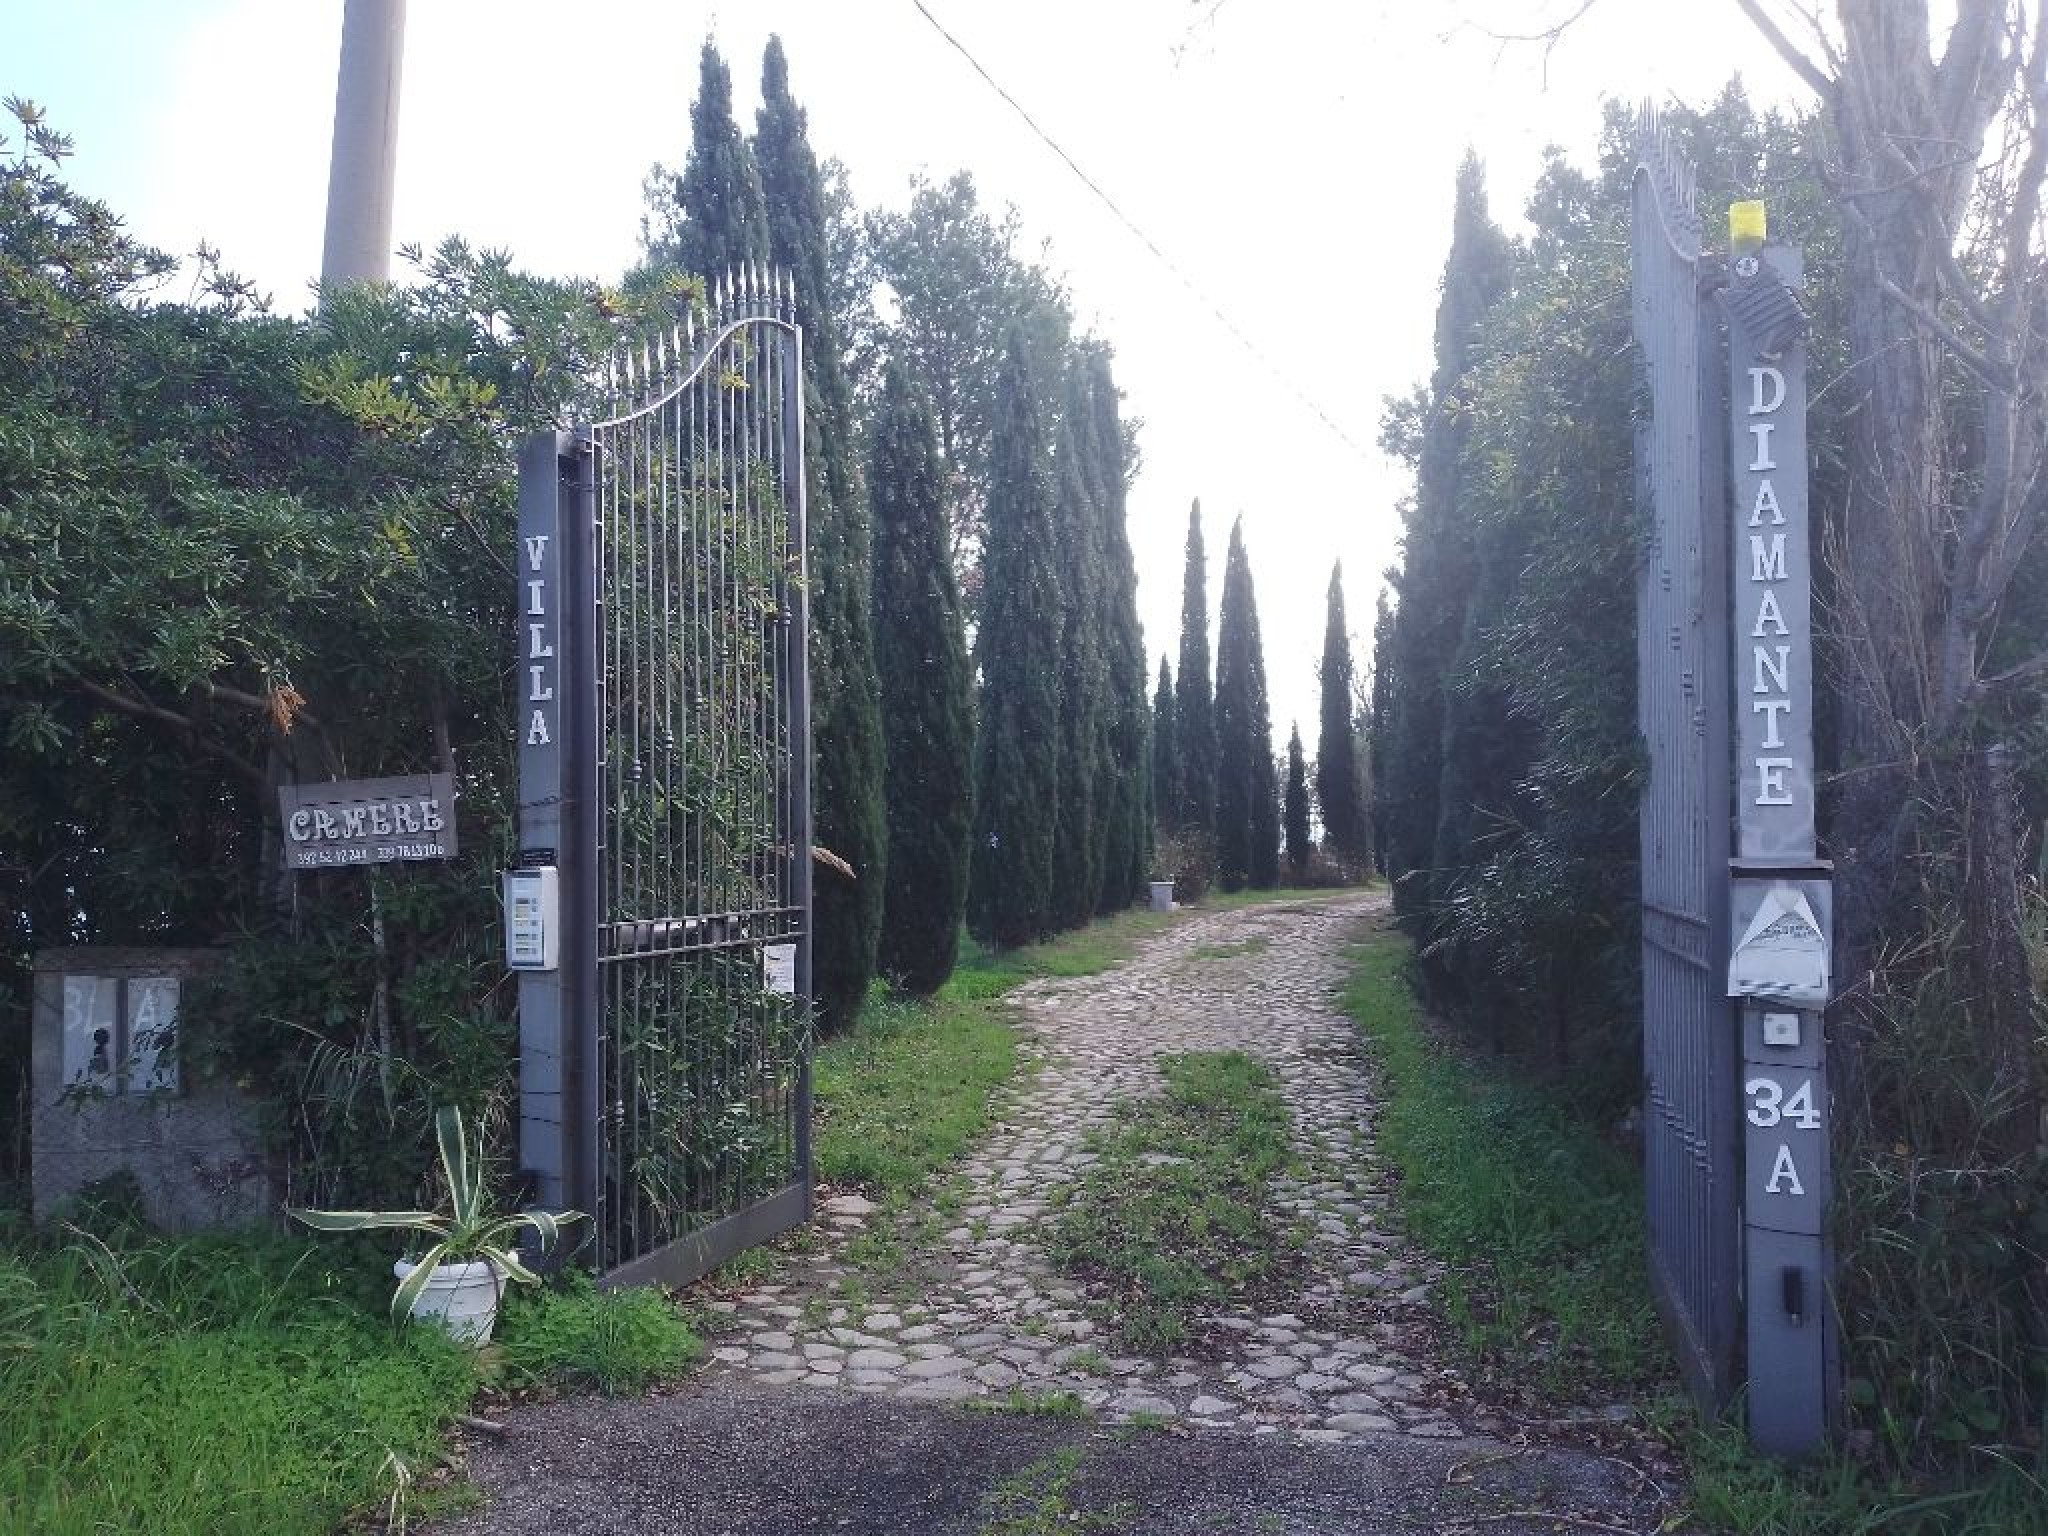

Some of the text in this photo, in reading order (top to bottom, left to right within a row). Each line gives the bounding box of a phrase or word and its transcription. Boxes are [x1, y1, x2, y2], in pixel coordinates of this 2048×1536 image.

[1747, 366, 1793, 805] DIAMANTE
[525, 535, 553, 745] VILLA
[289, 799, 445, 841] CAMERE
[1745, 1078, 1821, 1129] 34
[1765, 1144, 1805, 1195] A
